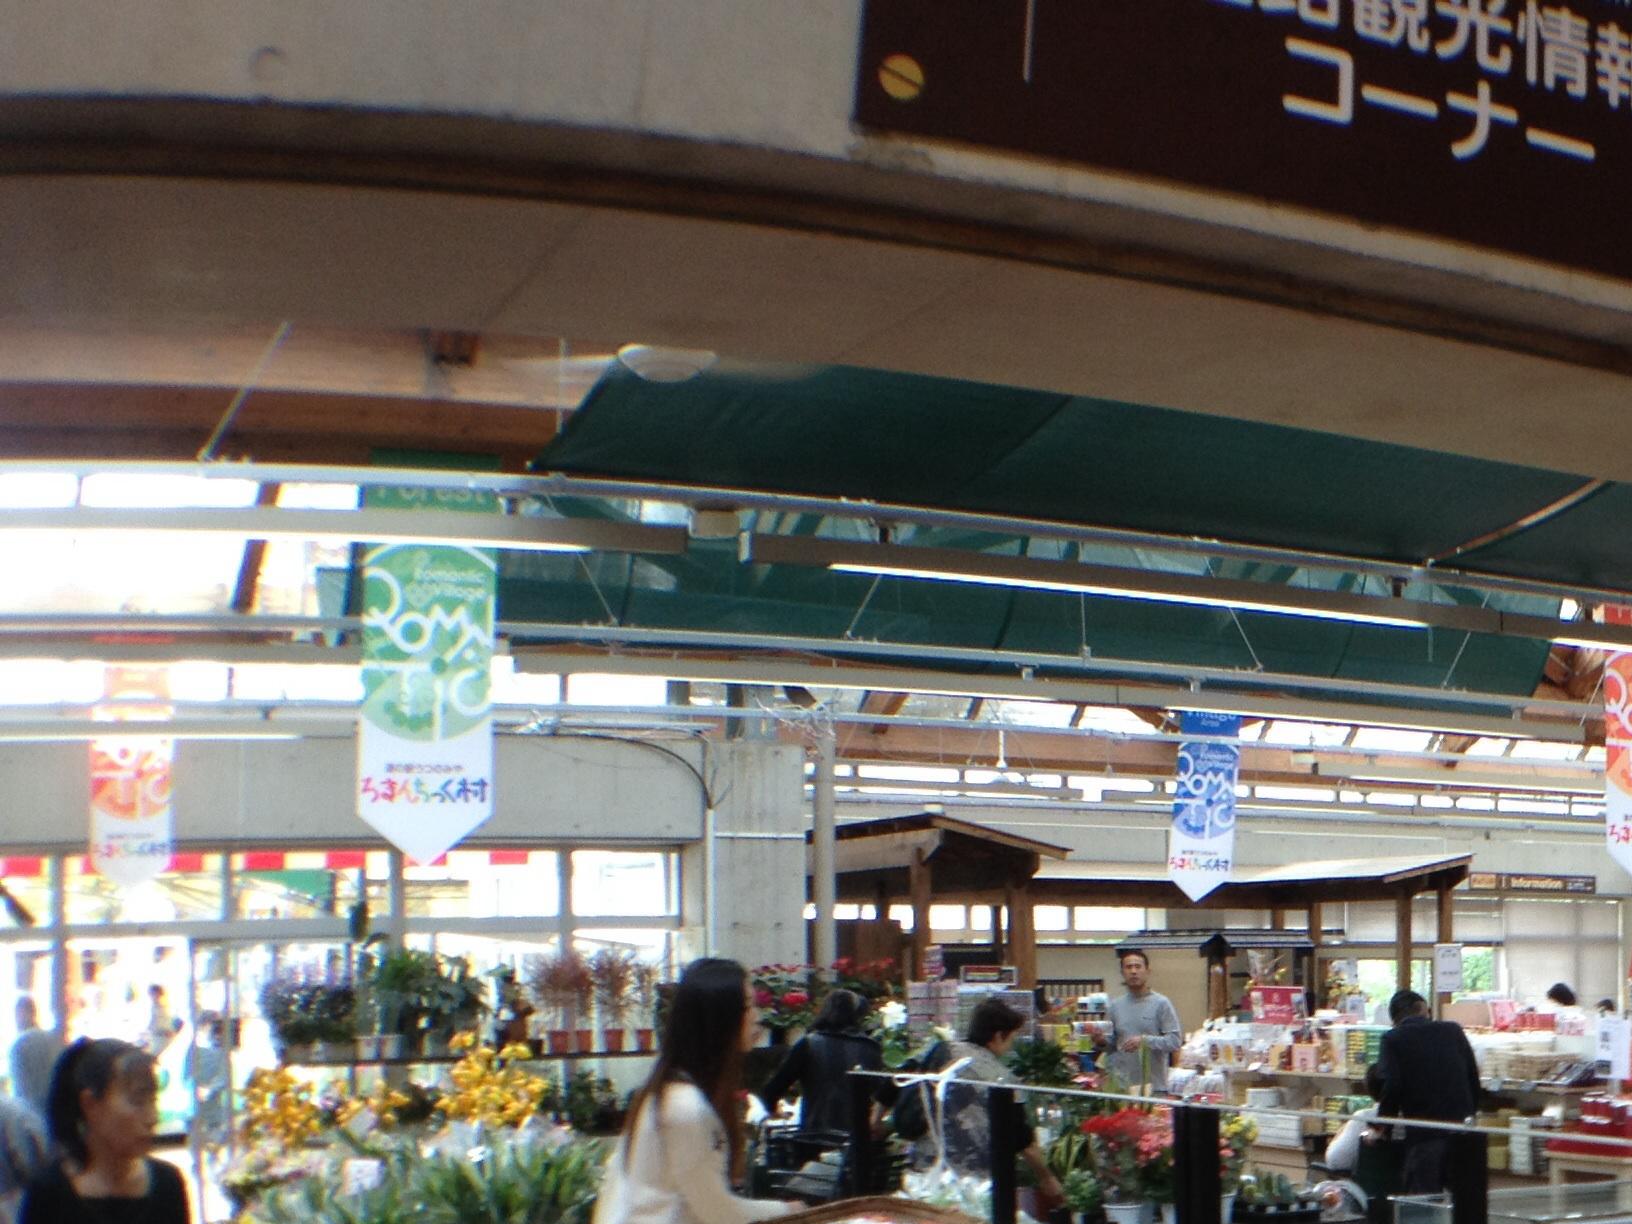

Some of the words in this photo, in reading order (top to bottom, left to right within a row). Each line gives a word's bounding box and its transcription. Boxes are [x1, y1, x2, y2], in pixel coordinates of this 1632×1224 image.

[1281, 35, 1597, 161] コーナー
[361, 776, 488, 804] ろまんちっく村
